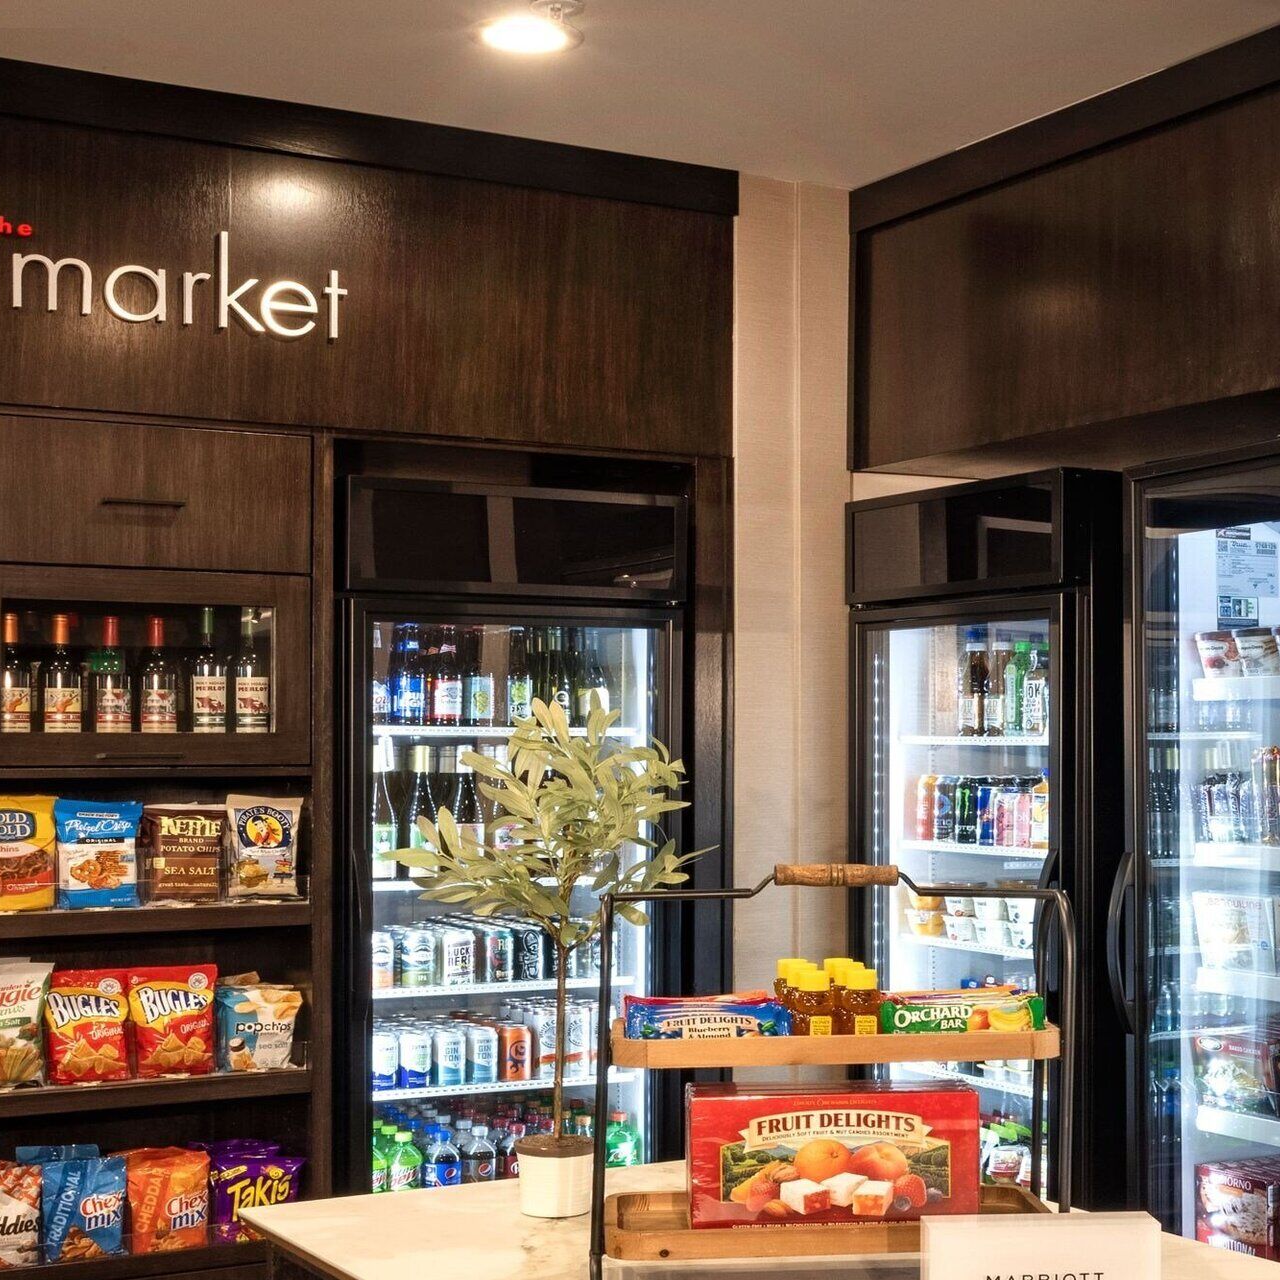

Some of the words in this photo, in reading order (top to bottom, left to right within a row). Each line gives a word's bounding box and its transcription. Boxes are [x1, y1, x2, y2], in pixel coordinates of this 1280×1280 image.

[12, 231, 348, 338] market
[164, 867, 185, 875] SEA
[188, 867, 216, 875] SALT
[48, 992, 119, 1028] BUGLES
[139, 987, 207, 1024] BUGLES
[894, 1005, 972, 1028] ORCHARD
[3, 1019, 20, 1028] Salt
[235, 1021, 292, 1035] popchips
[700, 1016, 751, 1026] DELIGHTS
[940, 1020, 964, 1029] BAR
[757, 1115, 814, 1136] FRUIT
[820, 1113, 915, 1132] DELIGHTS
[49, 1171, 81, 1246] TRADITIONAL
[80, 1192, 122, 1215] Chex
[166, 1192, 209, 1216] Chex
[227, 1176, 290, 1222] Takis
[85, 1209, 121, 1232] mix
[171, 1209, 207, 1232] mix
